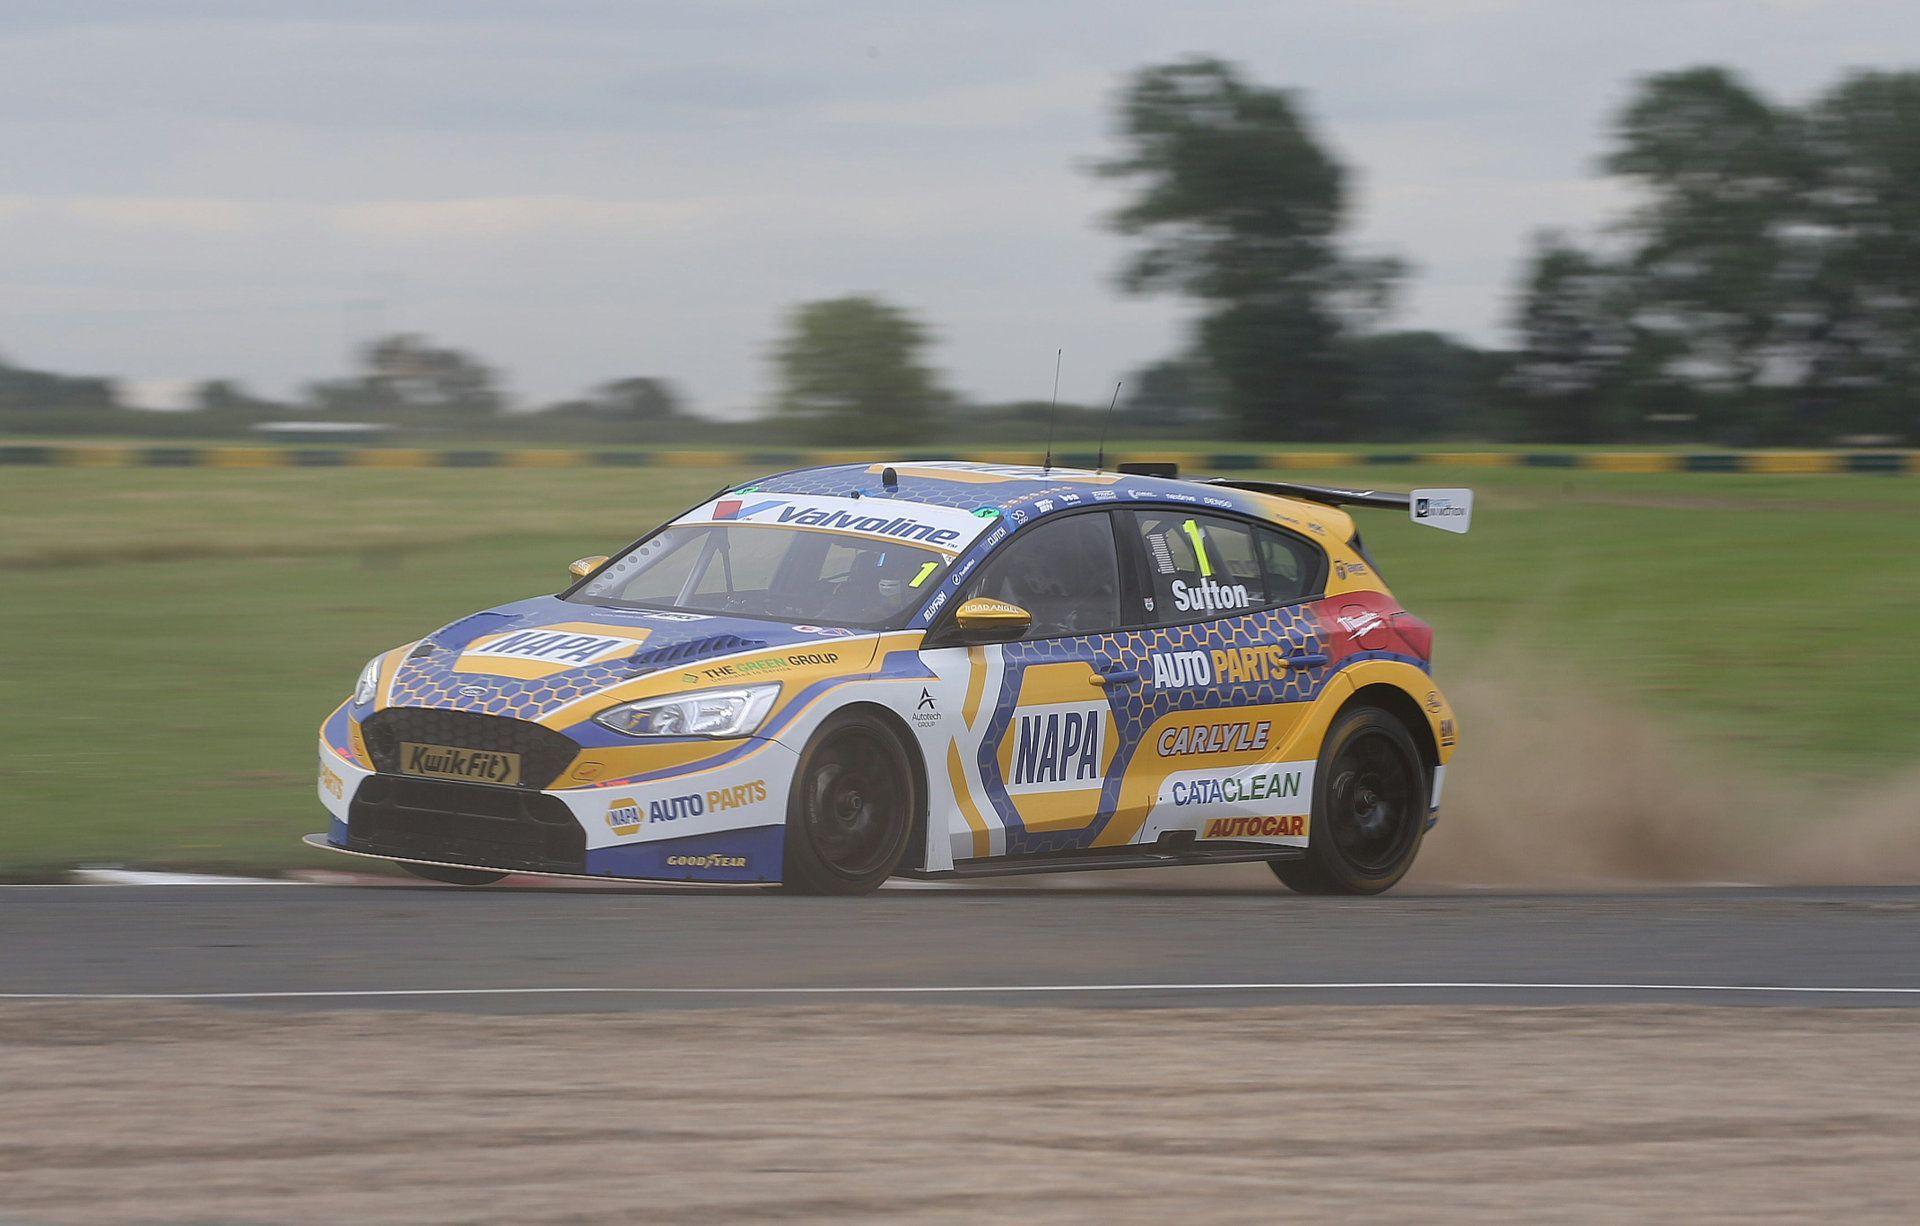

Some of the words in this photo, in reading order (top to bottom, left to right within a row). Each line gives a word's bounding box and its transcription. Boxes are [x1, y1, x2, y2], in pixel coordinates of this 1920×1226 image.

[777, 505, 960, 545] Valvoline
[987, 526, 1007, 546] CLUTCH
[1182, 519, 1212, 577] 1
[907, 560, 939, 588] 1
[965, 604, 989, 613] ROAD
[1171, 577, 1250, 612] Sutton
[479, 631, 623, 663] NAPA
[701, 665, 736, 678] THE
[736, 657, 788, 672] GREEN
[787, 652, 839, 667] GROUP
[1153, 650, 1211, 689] AUTO
[1210, 644, 1288, 684] PARTS
[912, 712, 942, 721] Autotech
[1015, 710, 1098, 785] NAPA
[1157, 721, 1272, 757] CARLYLE
[610, 807, 641, 827] NAPA
[649, 793, 704, 824] AUTO
[706, 779, 768, 813] PARTS
[1172, 772, 1302, 806] CATACLEAN
[1207, 815, 1304, 838] AUTOCAR
[666, 853, 748, 869] GOODYEAR
